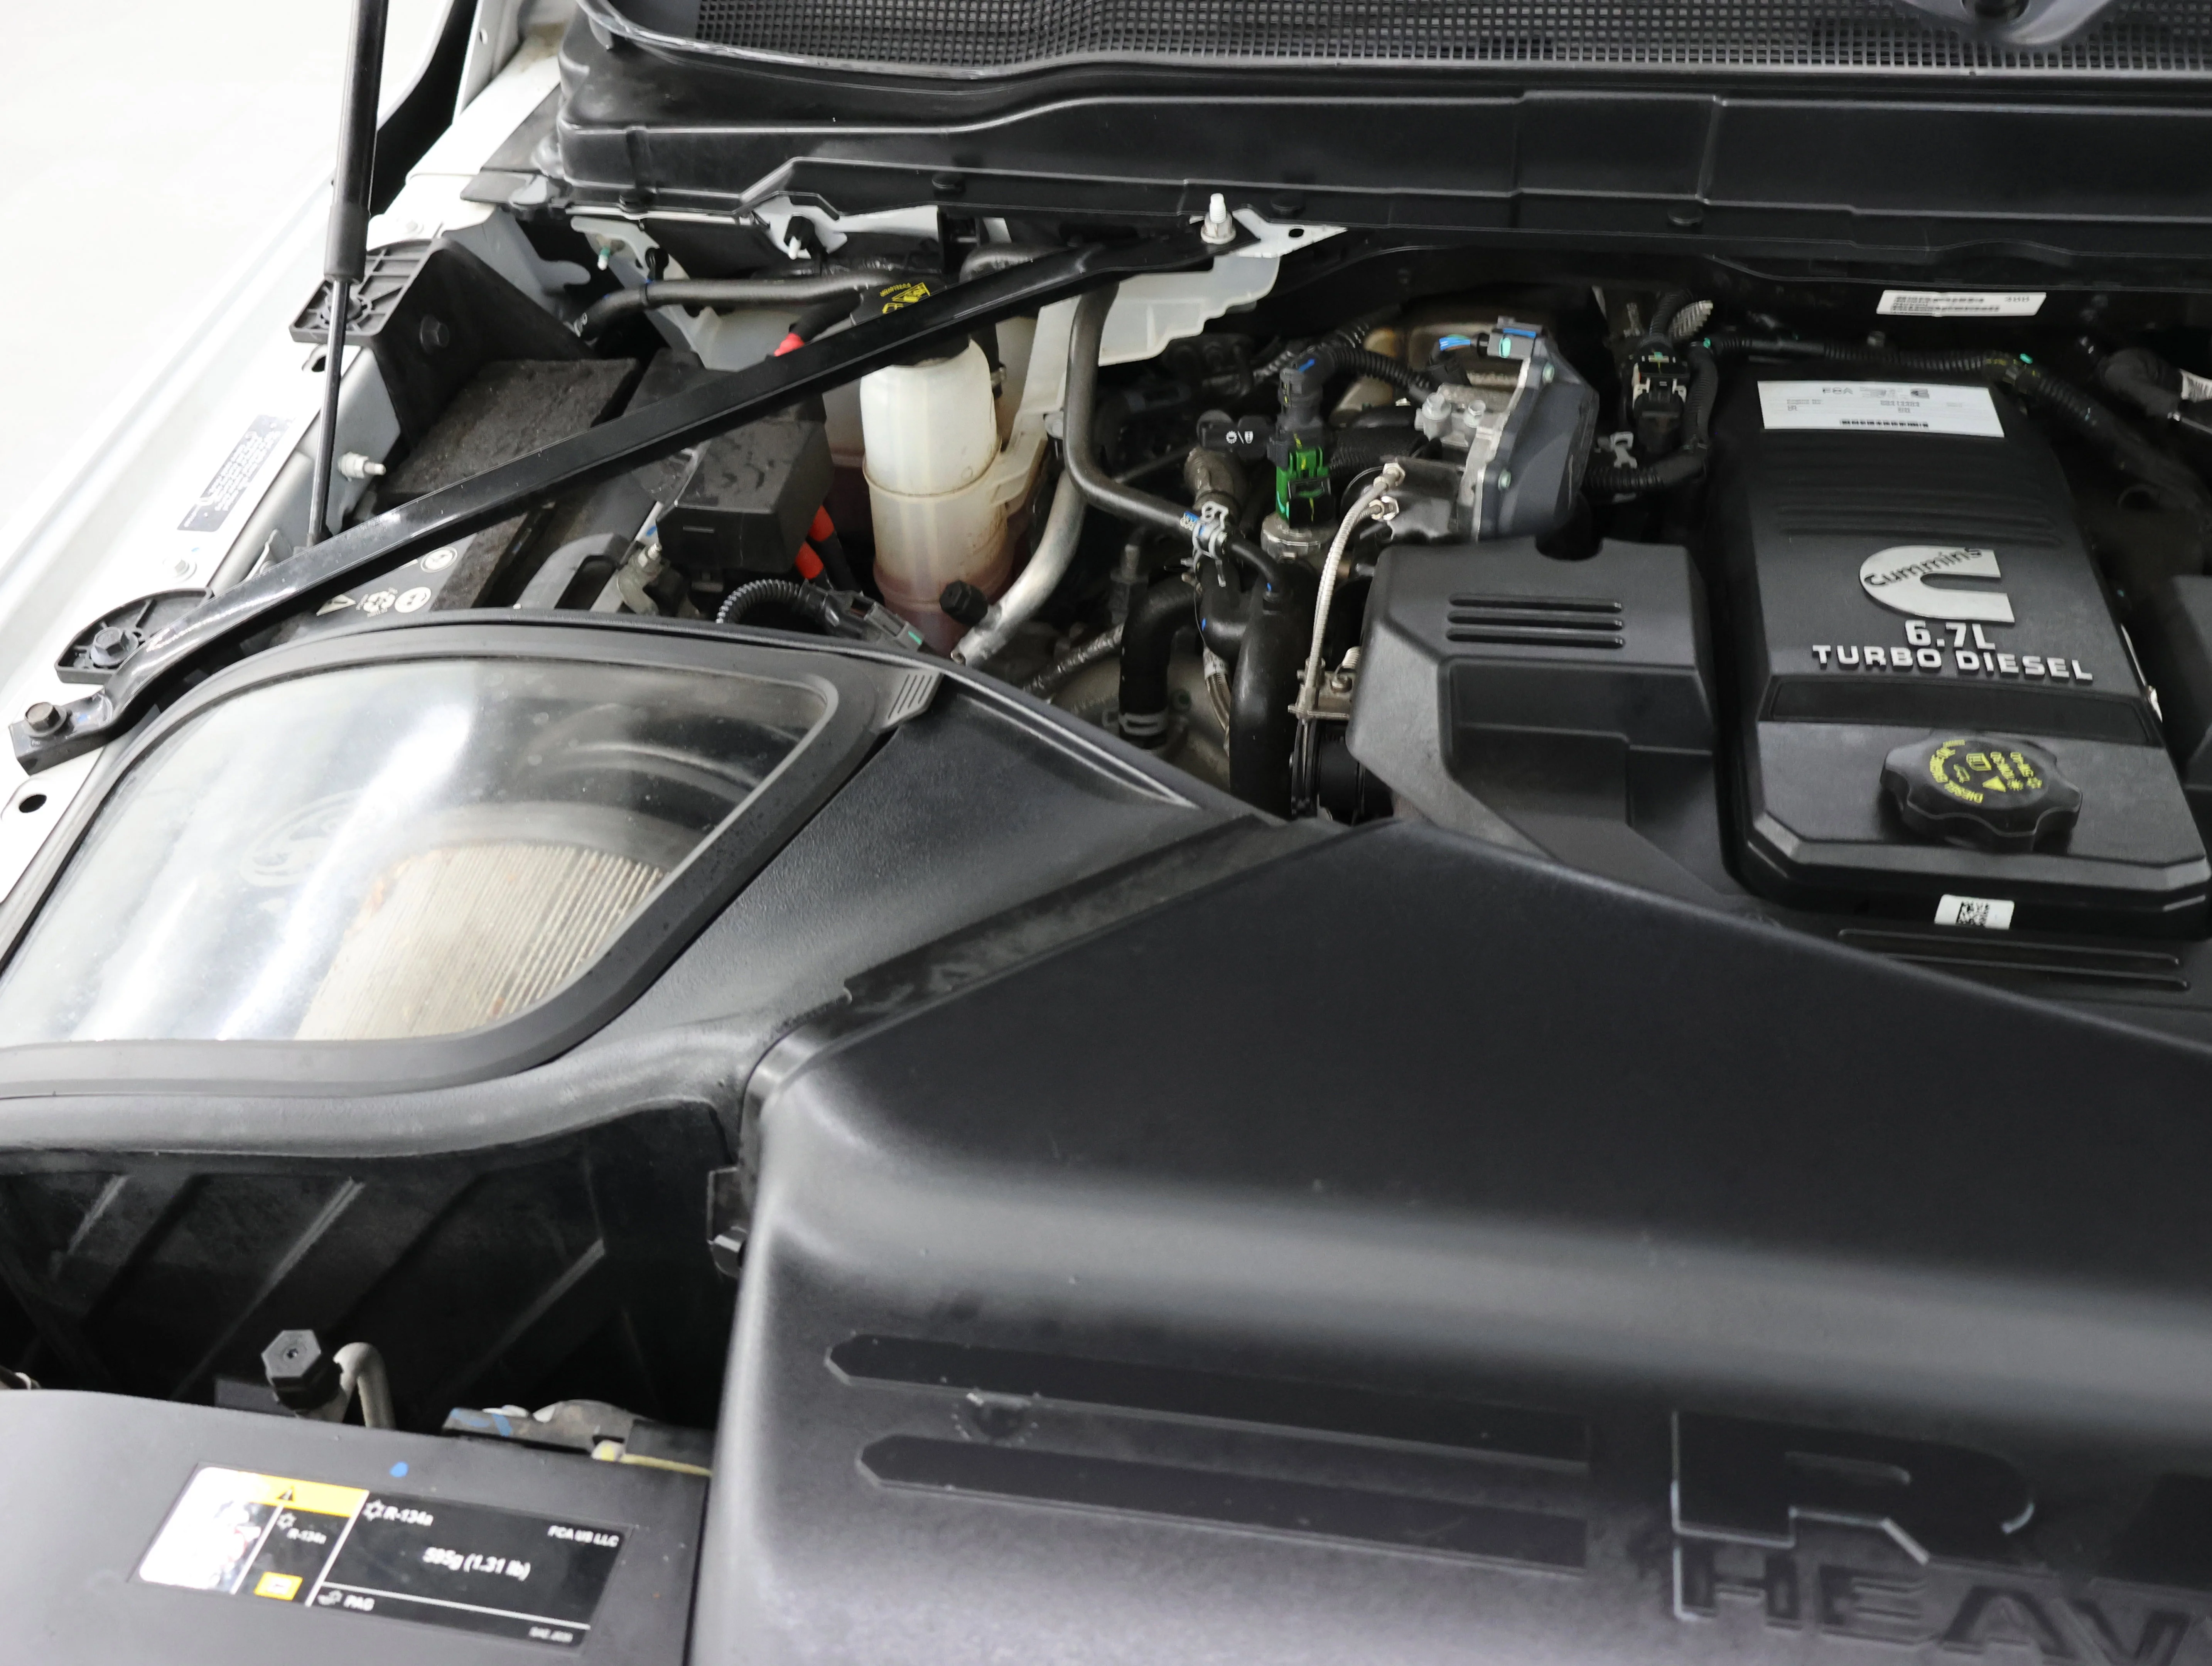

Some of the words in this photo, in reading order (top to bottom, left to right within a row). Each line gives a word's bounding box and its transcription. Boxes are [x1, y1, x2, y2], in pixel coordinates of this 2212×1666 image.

[1864, 547, 1983, 588] Cummins
[1905, 620, 1996, 650] 6.7L
[1812, 644, 1942, 669] TURBO
[1956, 651, 2093, 681] DIESEL
[383, 1506, 434, 1526] R-134a
[547, 1525, 574, 1541] FCA
[593, 1533, 619, 1547] LLC
[464, 1553, 506, 1574] (1.31
[505, 1560, 531, 1582] lb)
[344, 1595, 375, 1611] PAG
